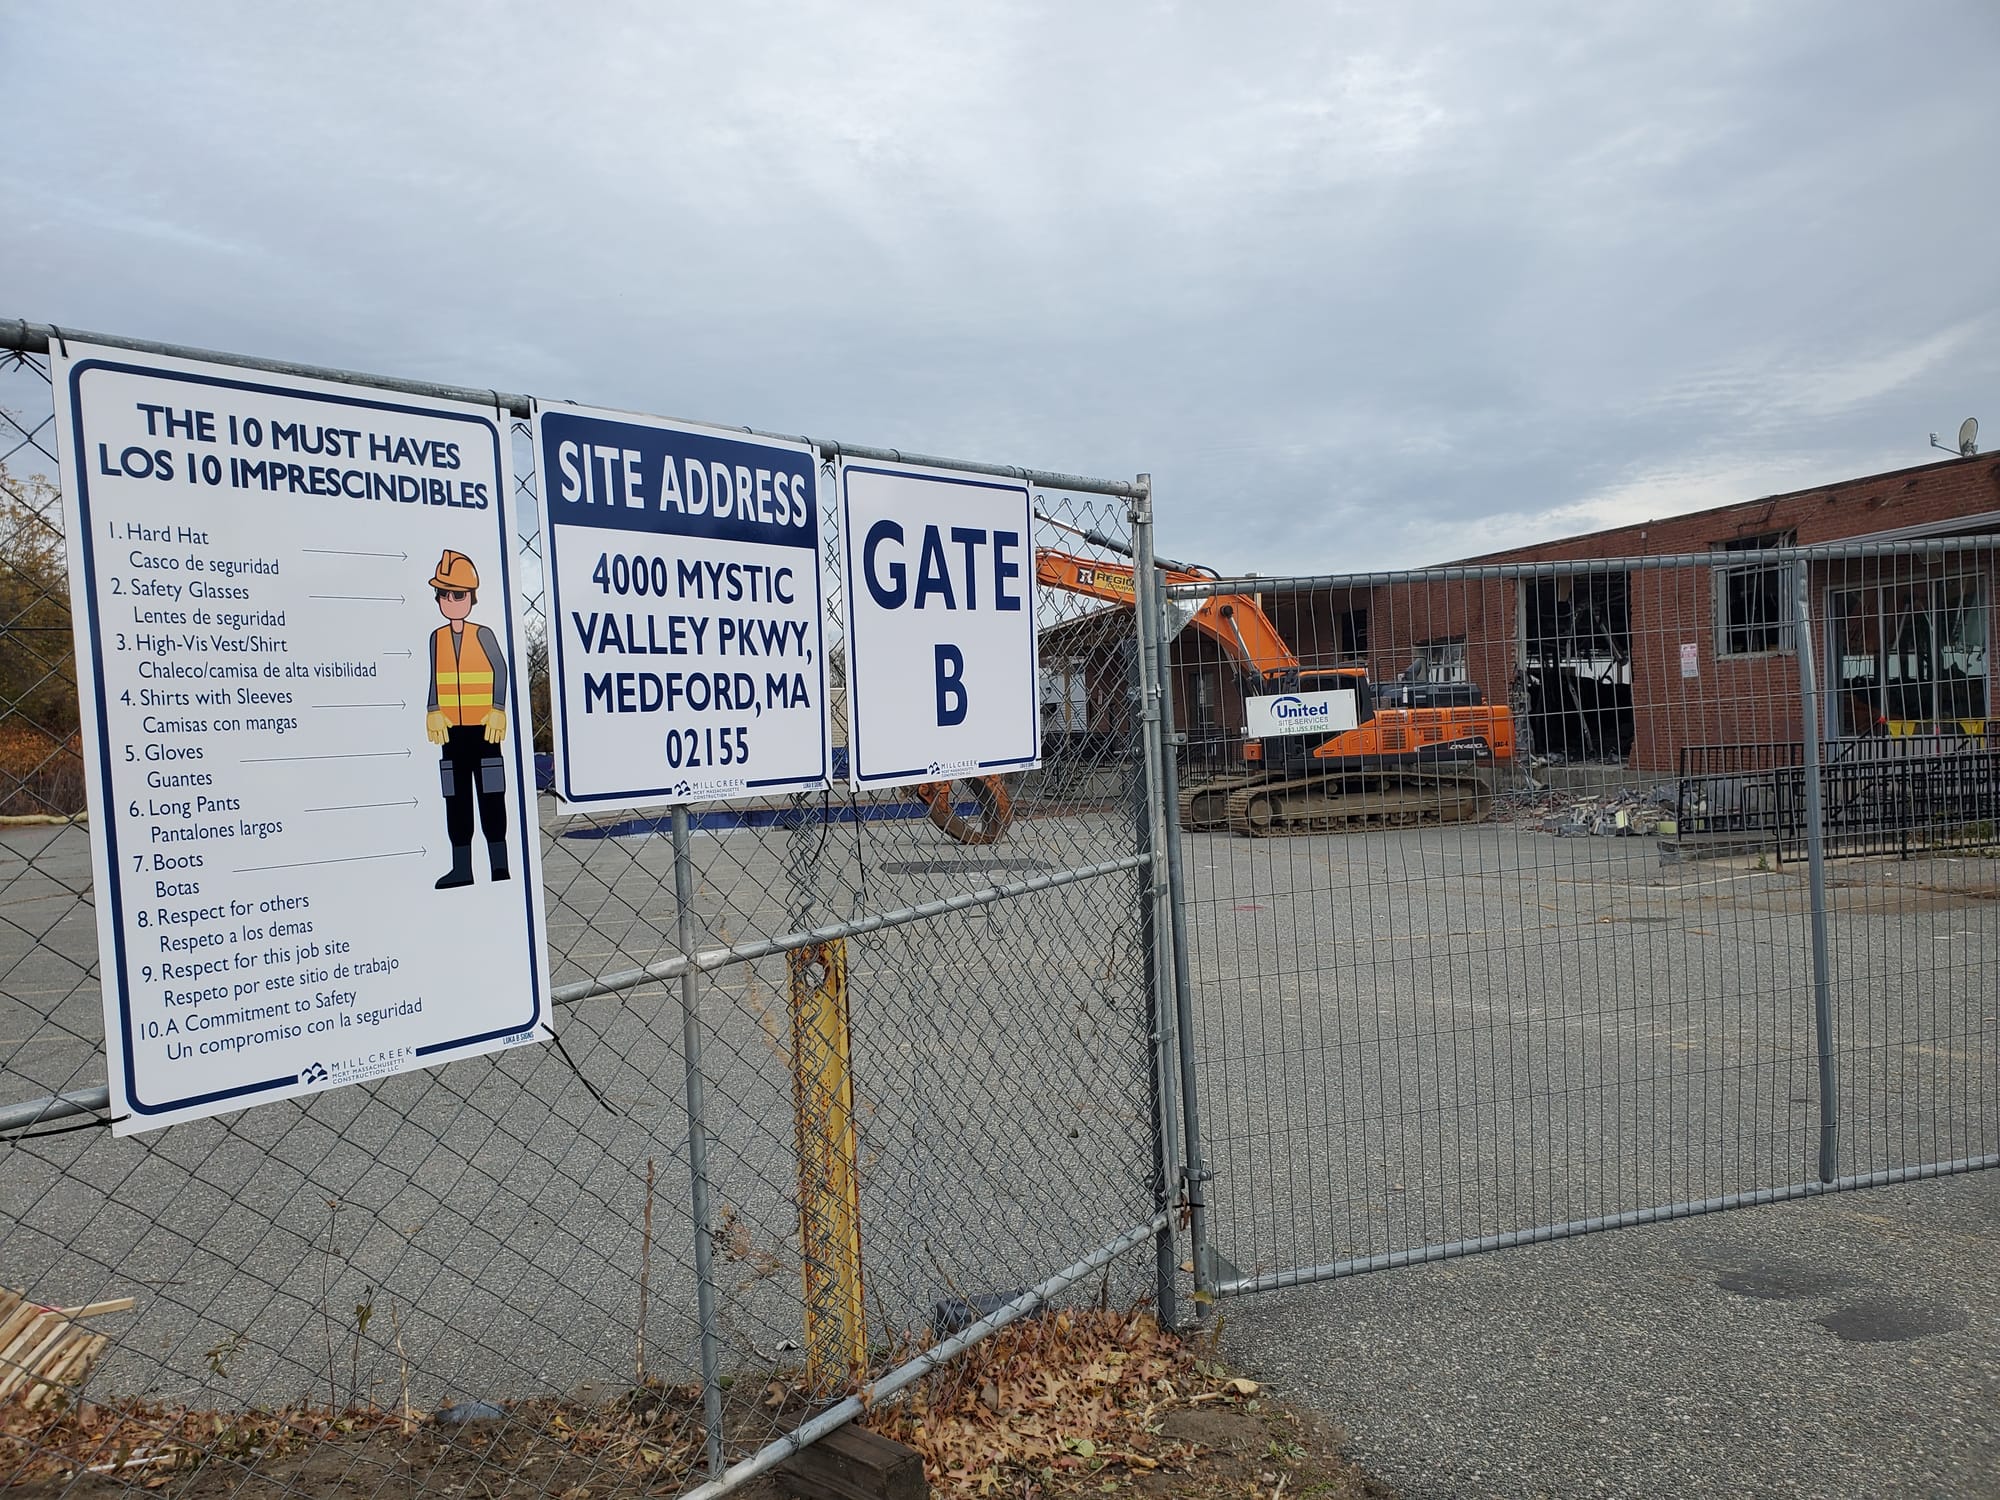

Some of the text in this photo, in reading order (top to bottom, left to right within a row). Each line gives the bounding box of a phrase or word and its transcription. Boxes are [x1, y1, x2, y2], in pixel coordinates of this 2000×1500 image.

[137, 403, 461, 470] THE 10 MUST HAVES
[99, 443, 488, 510] LOS 10 IMPRESCINDIBLES
[558, 440, 808, 529] SITE ADDRESS
[110, 521, 209, 545] 1. Hard Hat
[130, 551, 279, 578] Casco de seguridad
[863, 520, 1021, 611] GATE
[111, 577, 249, 603] 2. Safety Glasses
[593, 553, 794, 604] 4000 MYSTIC
[1096, 572, 1135, 587] REGIO
[1107, 583, 1135, 592] COMPA
[134, 606, 285, 630] Lentes de seguridad
[116, 633, 288, 656] 3. High-Vis Vest/Shirt
[571, 612, 812, 665] VALLEY PKWY,
[139, 661, 376, 679] Chaleco/camisa de alta visibilidad
[120, 688, 292, 706] 4. Shirts with Sleeves
[584, 672, 810, 718] MEDFORD, MA
[934, 644, 968, 727] B
[1276, 702, 1328, 718] United
[1278, 716, 1329, 727] SITE SERVICES
[143, 716, 297, 734] Camisas con mangas
[125, 744, 203, 762] 5. Gloves
[666, 727, 749, 768] 02155
[147, 771, 212, 788] Guantes
[692, 779, 745, 790] MILL CREEK
[130, 796, 240, 819] 6. Long Pants
[152, 820, 282, 843] Pantalones largos
[133, 854, 203, 872] 7. Boots
[156, 881, 200, 898] Botas
[138, 895, 309, 928] 8. Respect for others
[160, 920, 313, 954] Respeto a los demas
[142, 940, 350, 983] 9. Respect for this job site
[164, 956, 399, 1008] Respeto por este sitio de trabajo
[185, 1002, 291, 1031] Commitment
[294, 1000, 311, 1012] to
[315, 990, 356, 1008] Safety
[167, 997, 422, 1060] Un compromiso con la seguridad
[331, 1046, 413, 1072] MILL CREEK
[332, 1065, 399, 1085] CONSTRUCTION LLC
